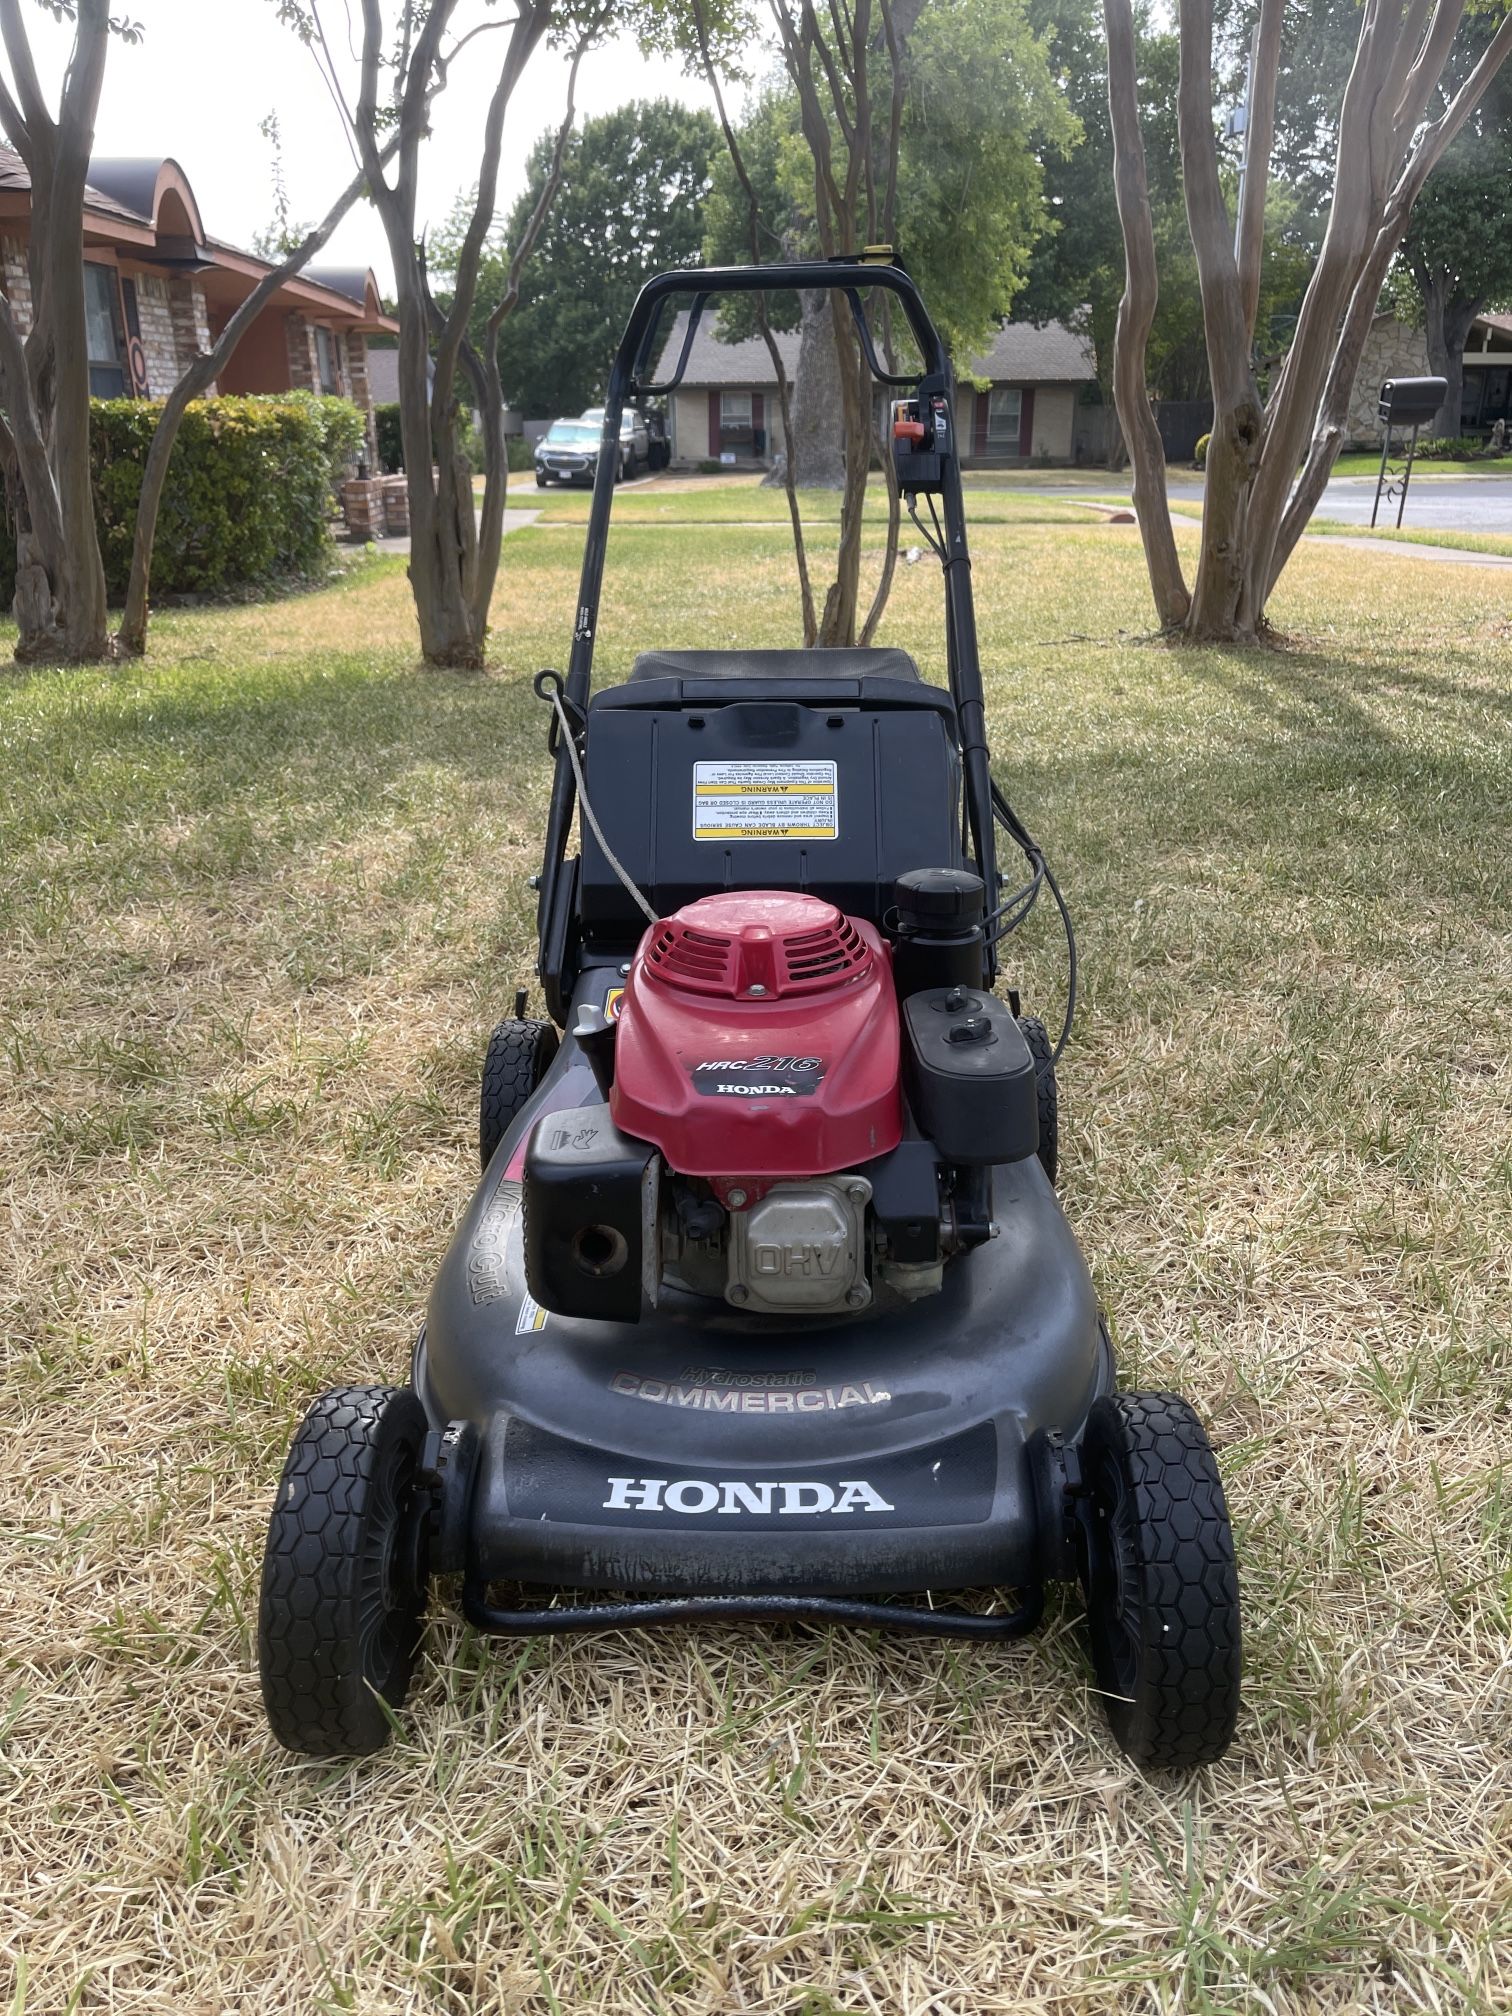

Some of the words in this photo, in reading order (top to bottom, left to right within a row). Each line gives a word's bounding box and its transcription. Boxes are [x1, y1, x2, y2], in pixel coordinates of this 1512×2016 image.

[716, 1084, 797, 1095] HONDA
[472, 1179, 523, 1250] Micro
[470, 1252, 509, 1305] Cut
[755, 1243, 842, 1276] OHV
[607, 1370, 892, 1414] COMMERCIAL
[679, 1366, 817, 1388] Hydrostatic
[602, 1477, 895, 1515] HONDA
